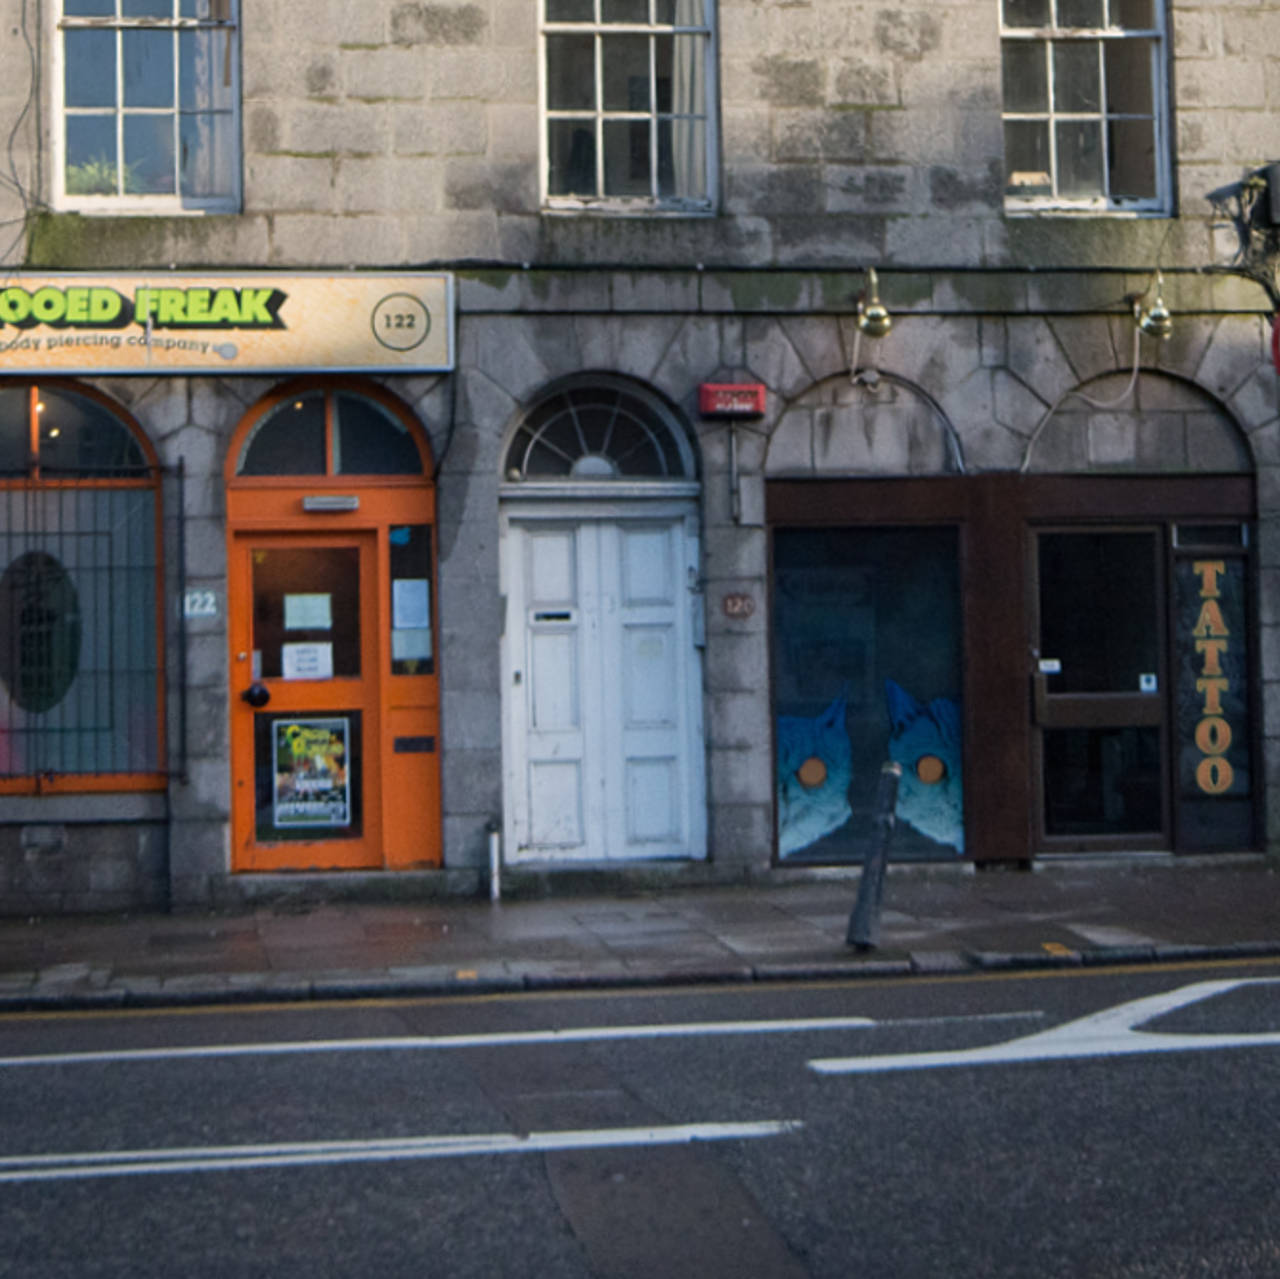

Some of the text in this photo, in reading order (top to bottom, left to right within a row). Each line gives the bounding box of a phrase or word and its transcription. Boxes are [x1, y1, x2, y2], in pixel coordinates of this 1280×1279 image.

[134, 286, 281, 326] FREAK
[384, 313, 416, 329] 122
[47, 332, 121, 350] piercing
[126, 333, 211, 354] company
[184, 590, 217, 617] 122
[1192, 560, 1234, 795] TATTOO
